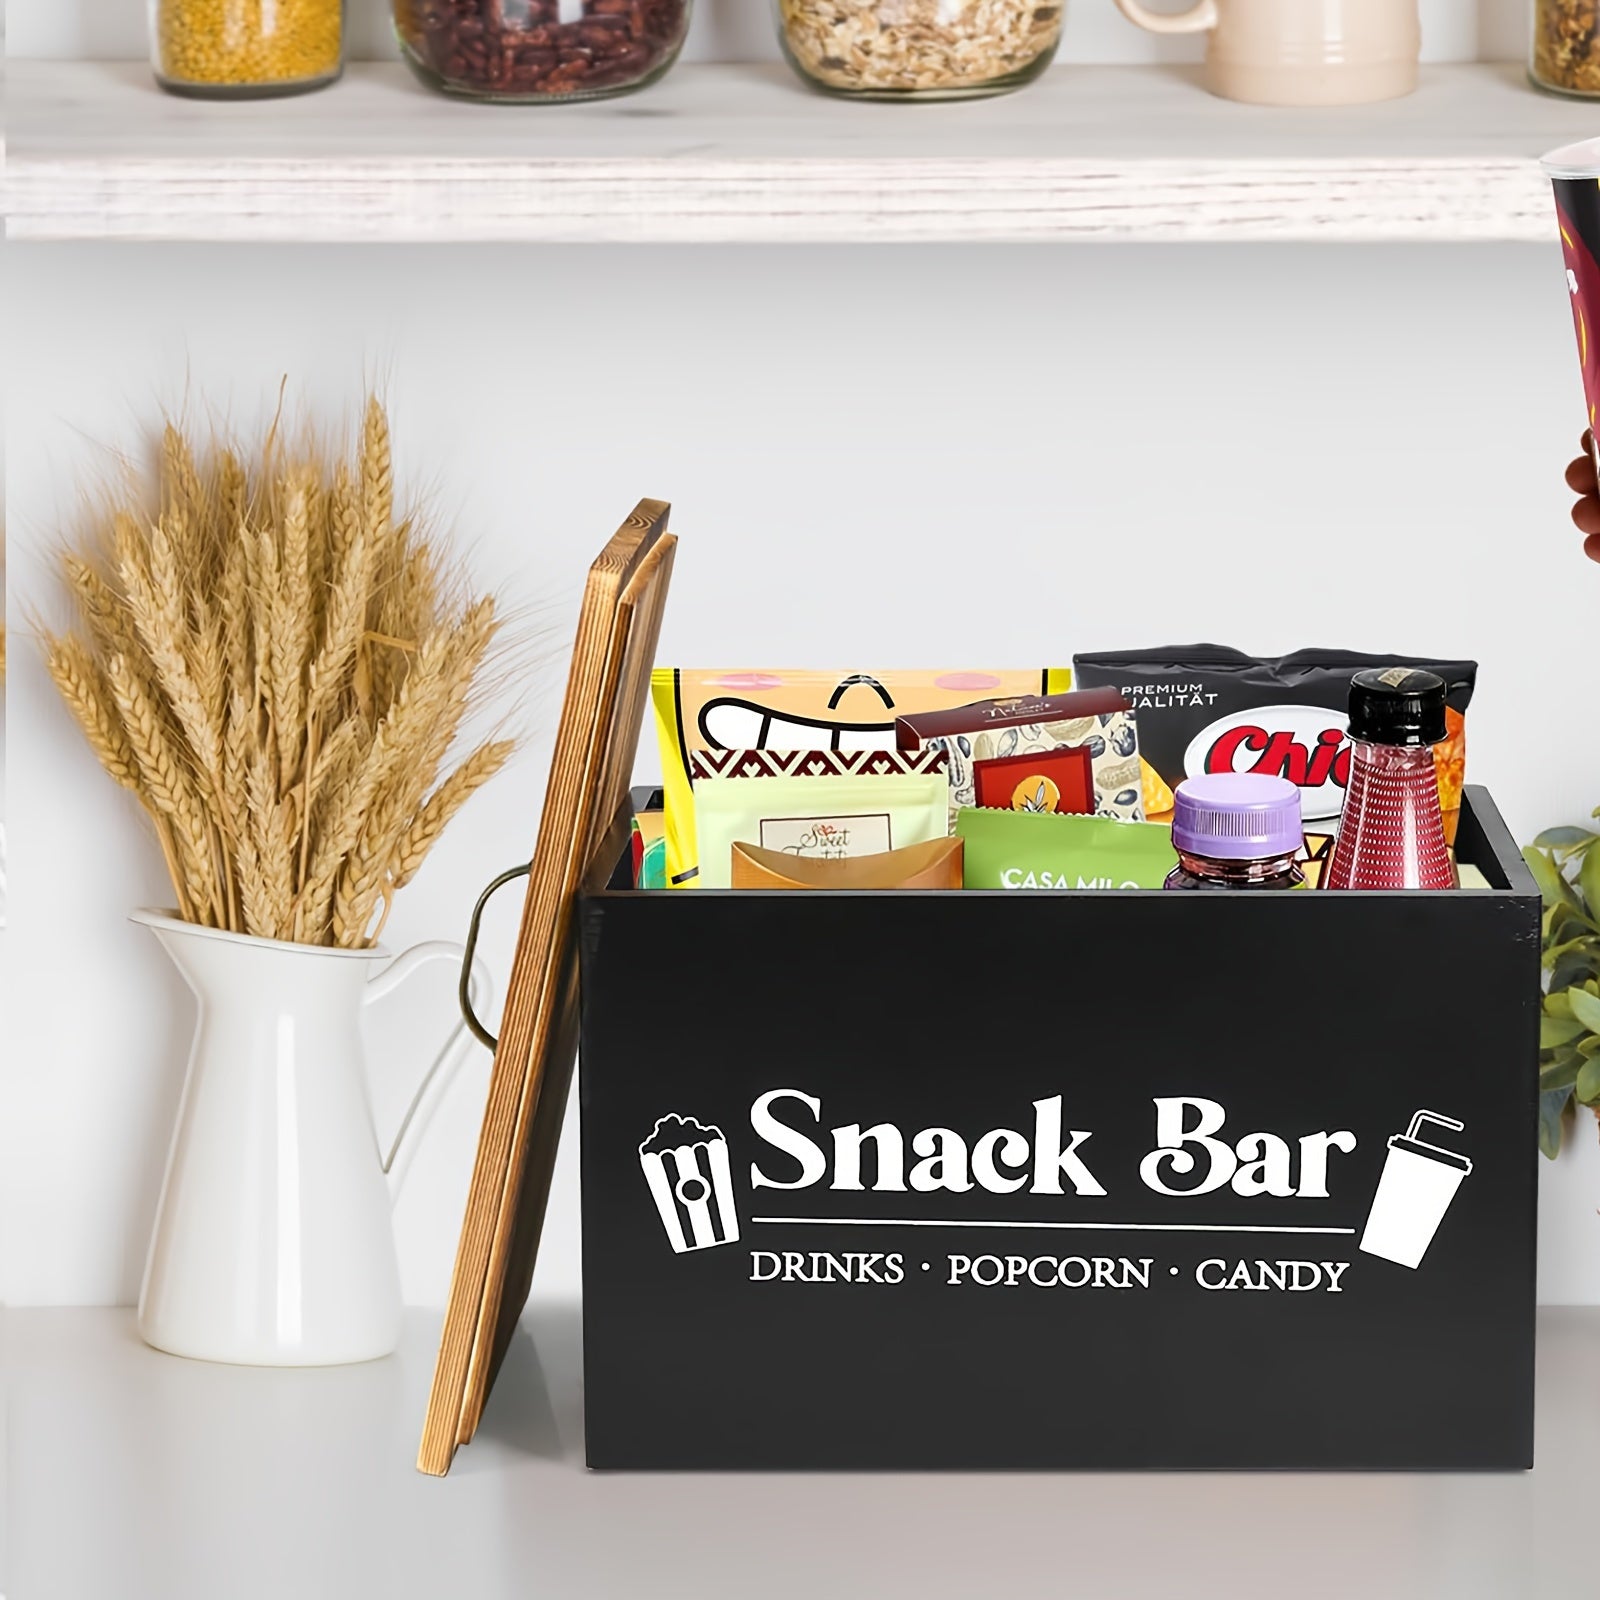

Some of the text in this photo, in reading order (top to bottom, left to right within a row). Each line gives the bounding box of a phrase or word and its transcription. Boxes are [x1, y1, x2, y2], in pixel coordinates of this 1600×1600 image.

[1121, 684, 1203, 696] PREMIUM
[800, 824, 850, 848] Sweet
[1001, 868, 1069, 890] CASA
[750, 1088, 1357, 1198] Snack Bar
[750, 1251, 1351, 1293] DRINKS POPCORN CANDY
